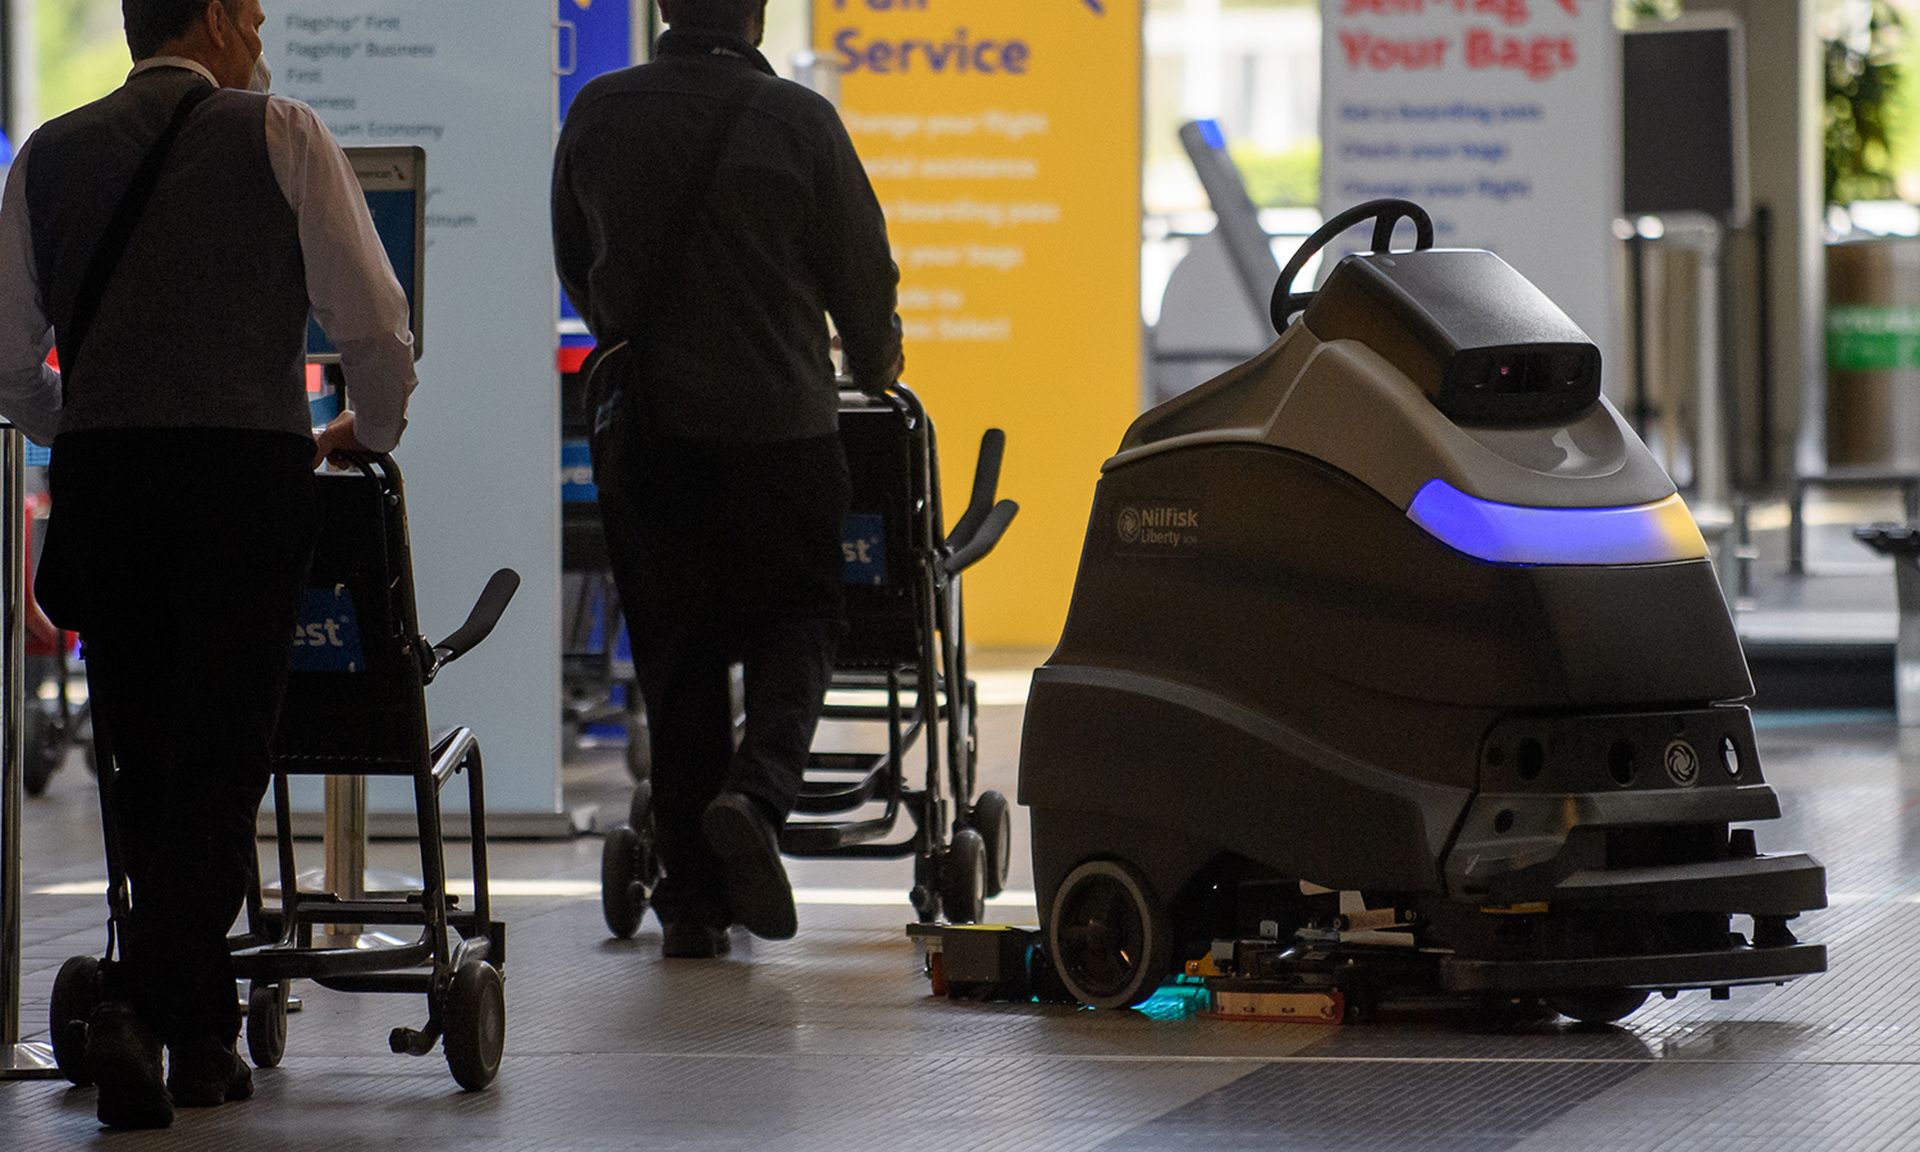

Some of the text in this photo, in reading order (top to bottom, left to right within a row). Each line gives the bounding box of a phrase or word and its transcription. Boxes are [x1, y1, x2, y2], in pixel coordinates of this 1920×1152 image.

[365, 15, 400, 30] First
[365, 43, 435, 58] Business
[832, 27, 1030, 75] Service
[1338, 26, 1577, 81] Your Bags
[286, 68, 321, 83] First
[367, 122, 444, 141] Economy
[843, 113, 919, 141] hange
[1141, 508, 1199, 528] Nilfisk
[1140, 529, 1180, 547] Liberty
